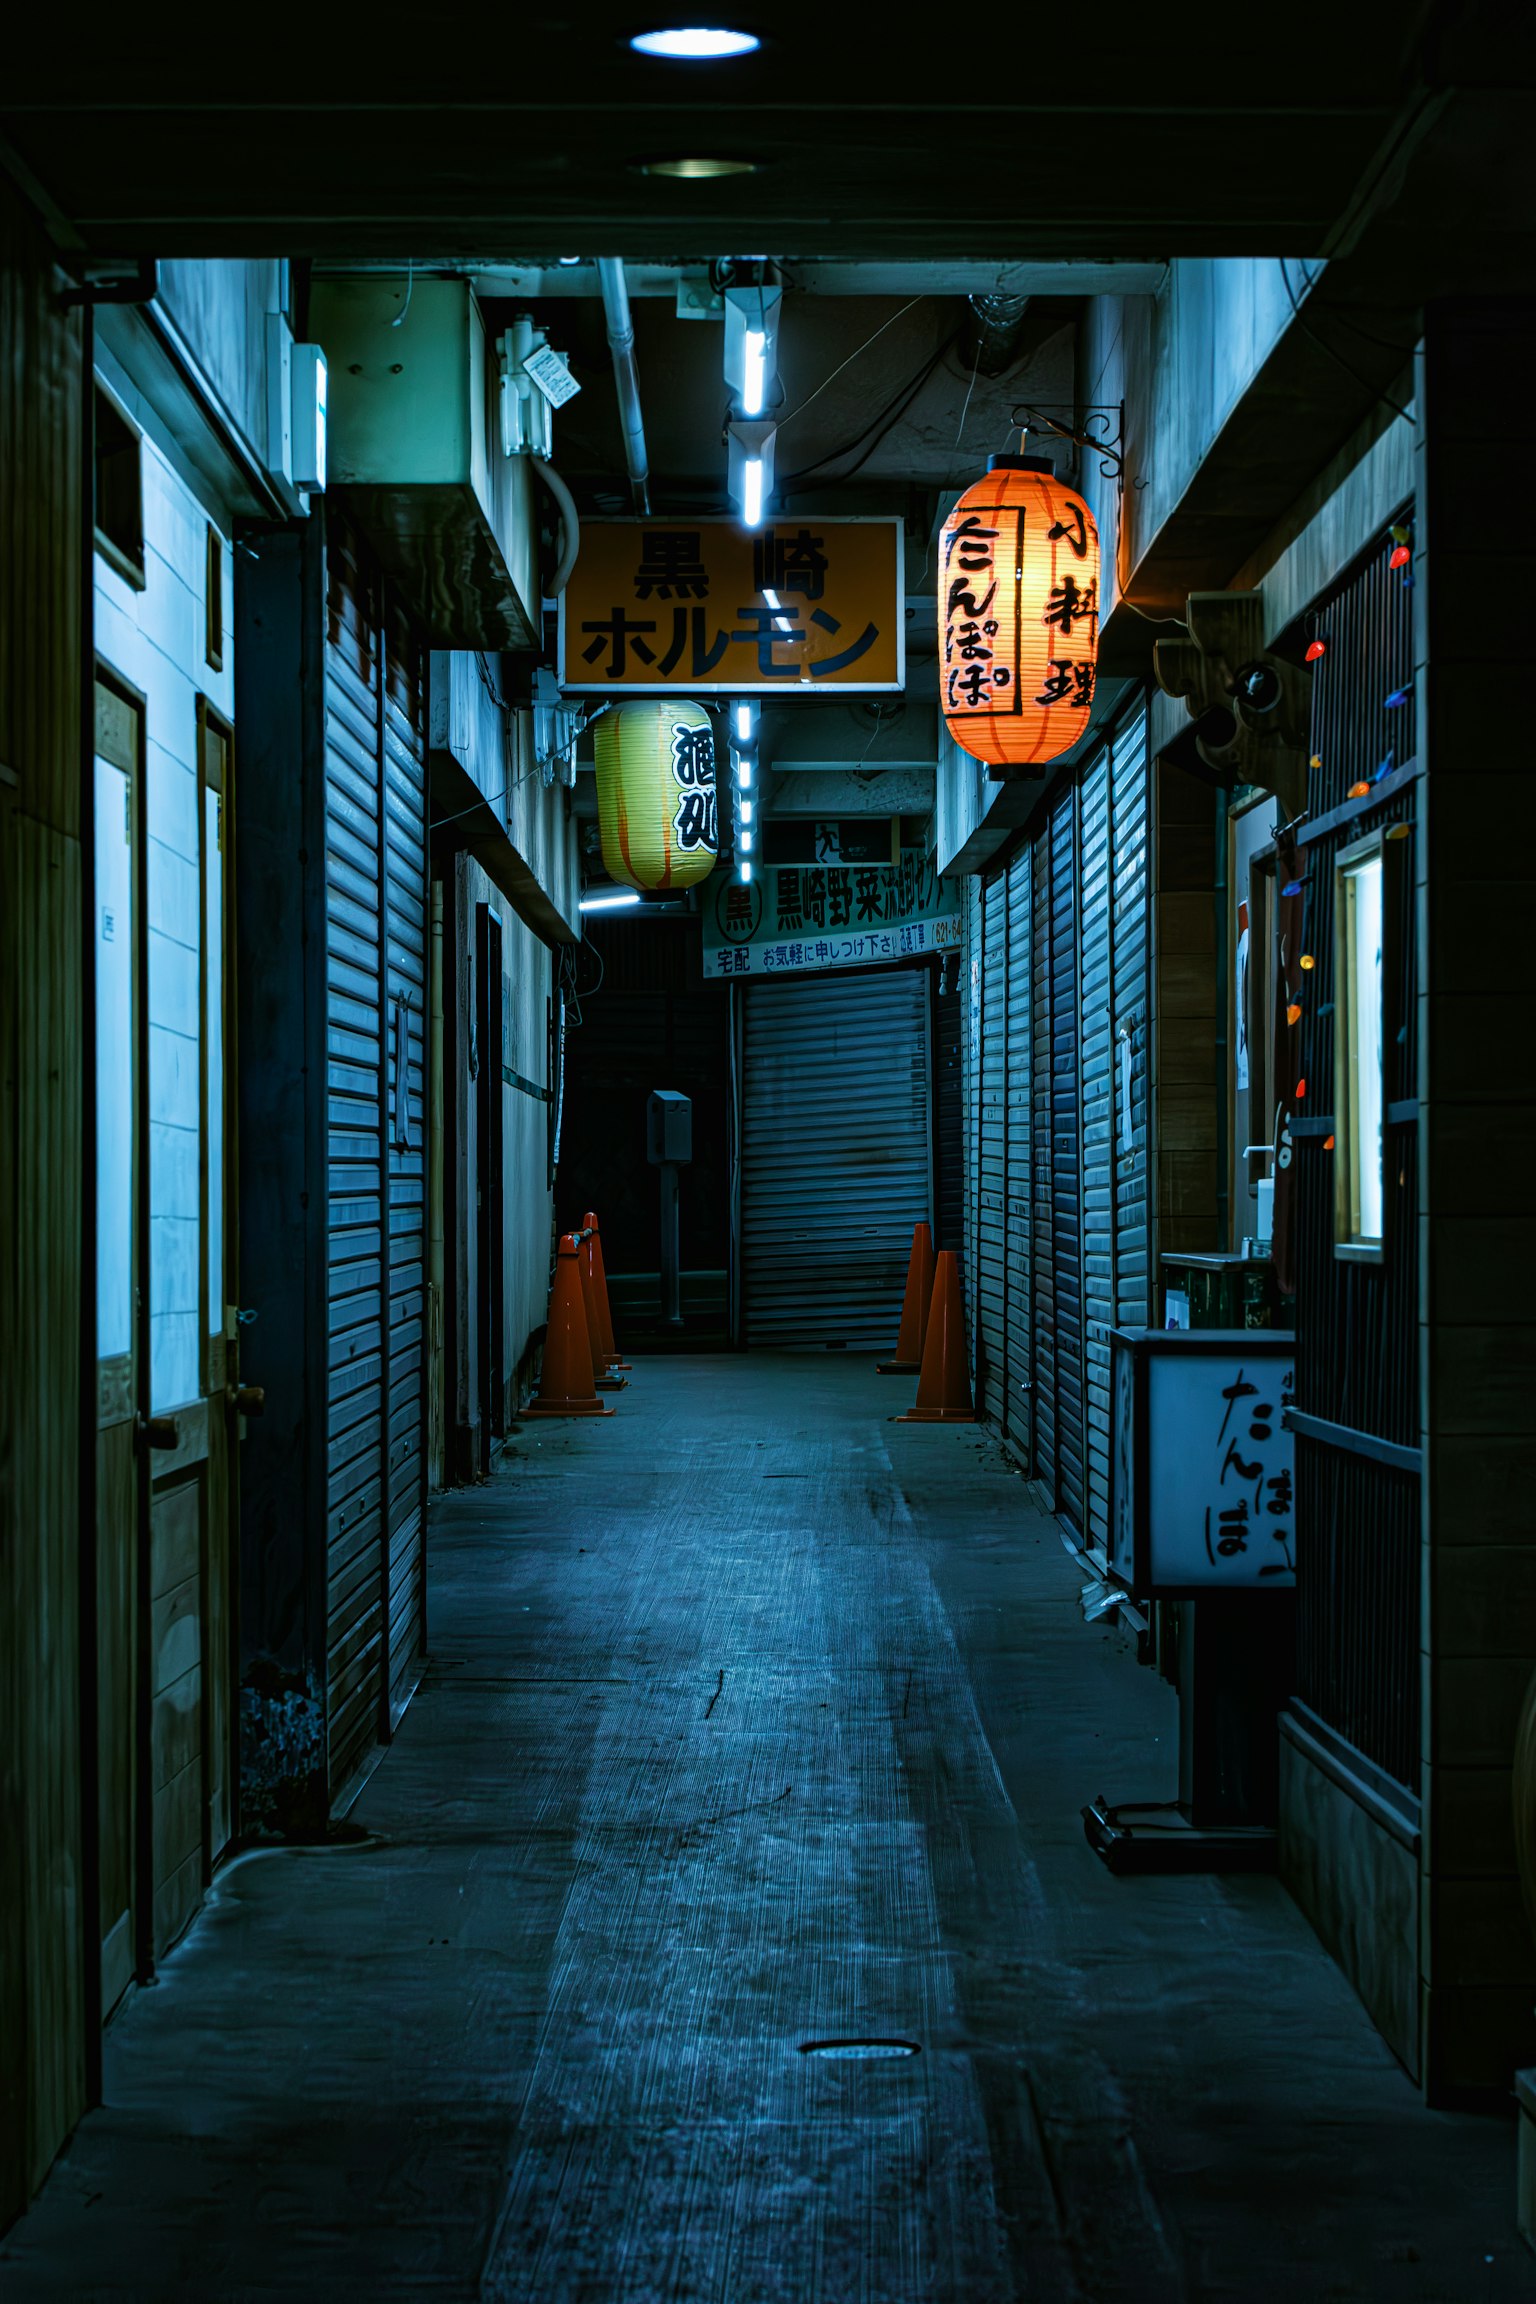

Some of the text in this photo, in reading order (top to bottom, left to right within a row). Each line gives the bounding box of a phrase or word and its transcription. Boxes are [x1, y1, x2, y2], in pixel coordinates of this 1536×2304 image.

[633, 529, 828, 600] 黒崎
[1034, 502, 1099, 707] 小料理
[581, 606, 880, 678] ホルモン
[717, 947, 751, 975] 宅配
